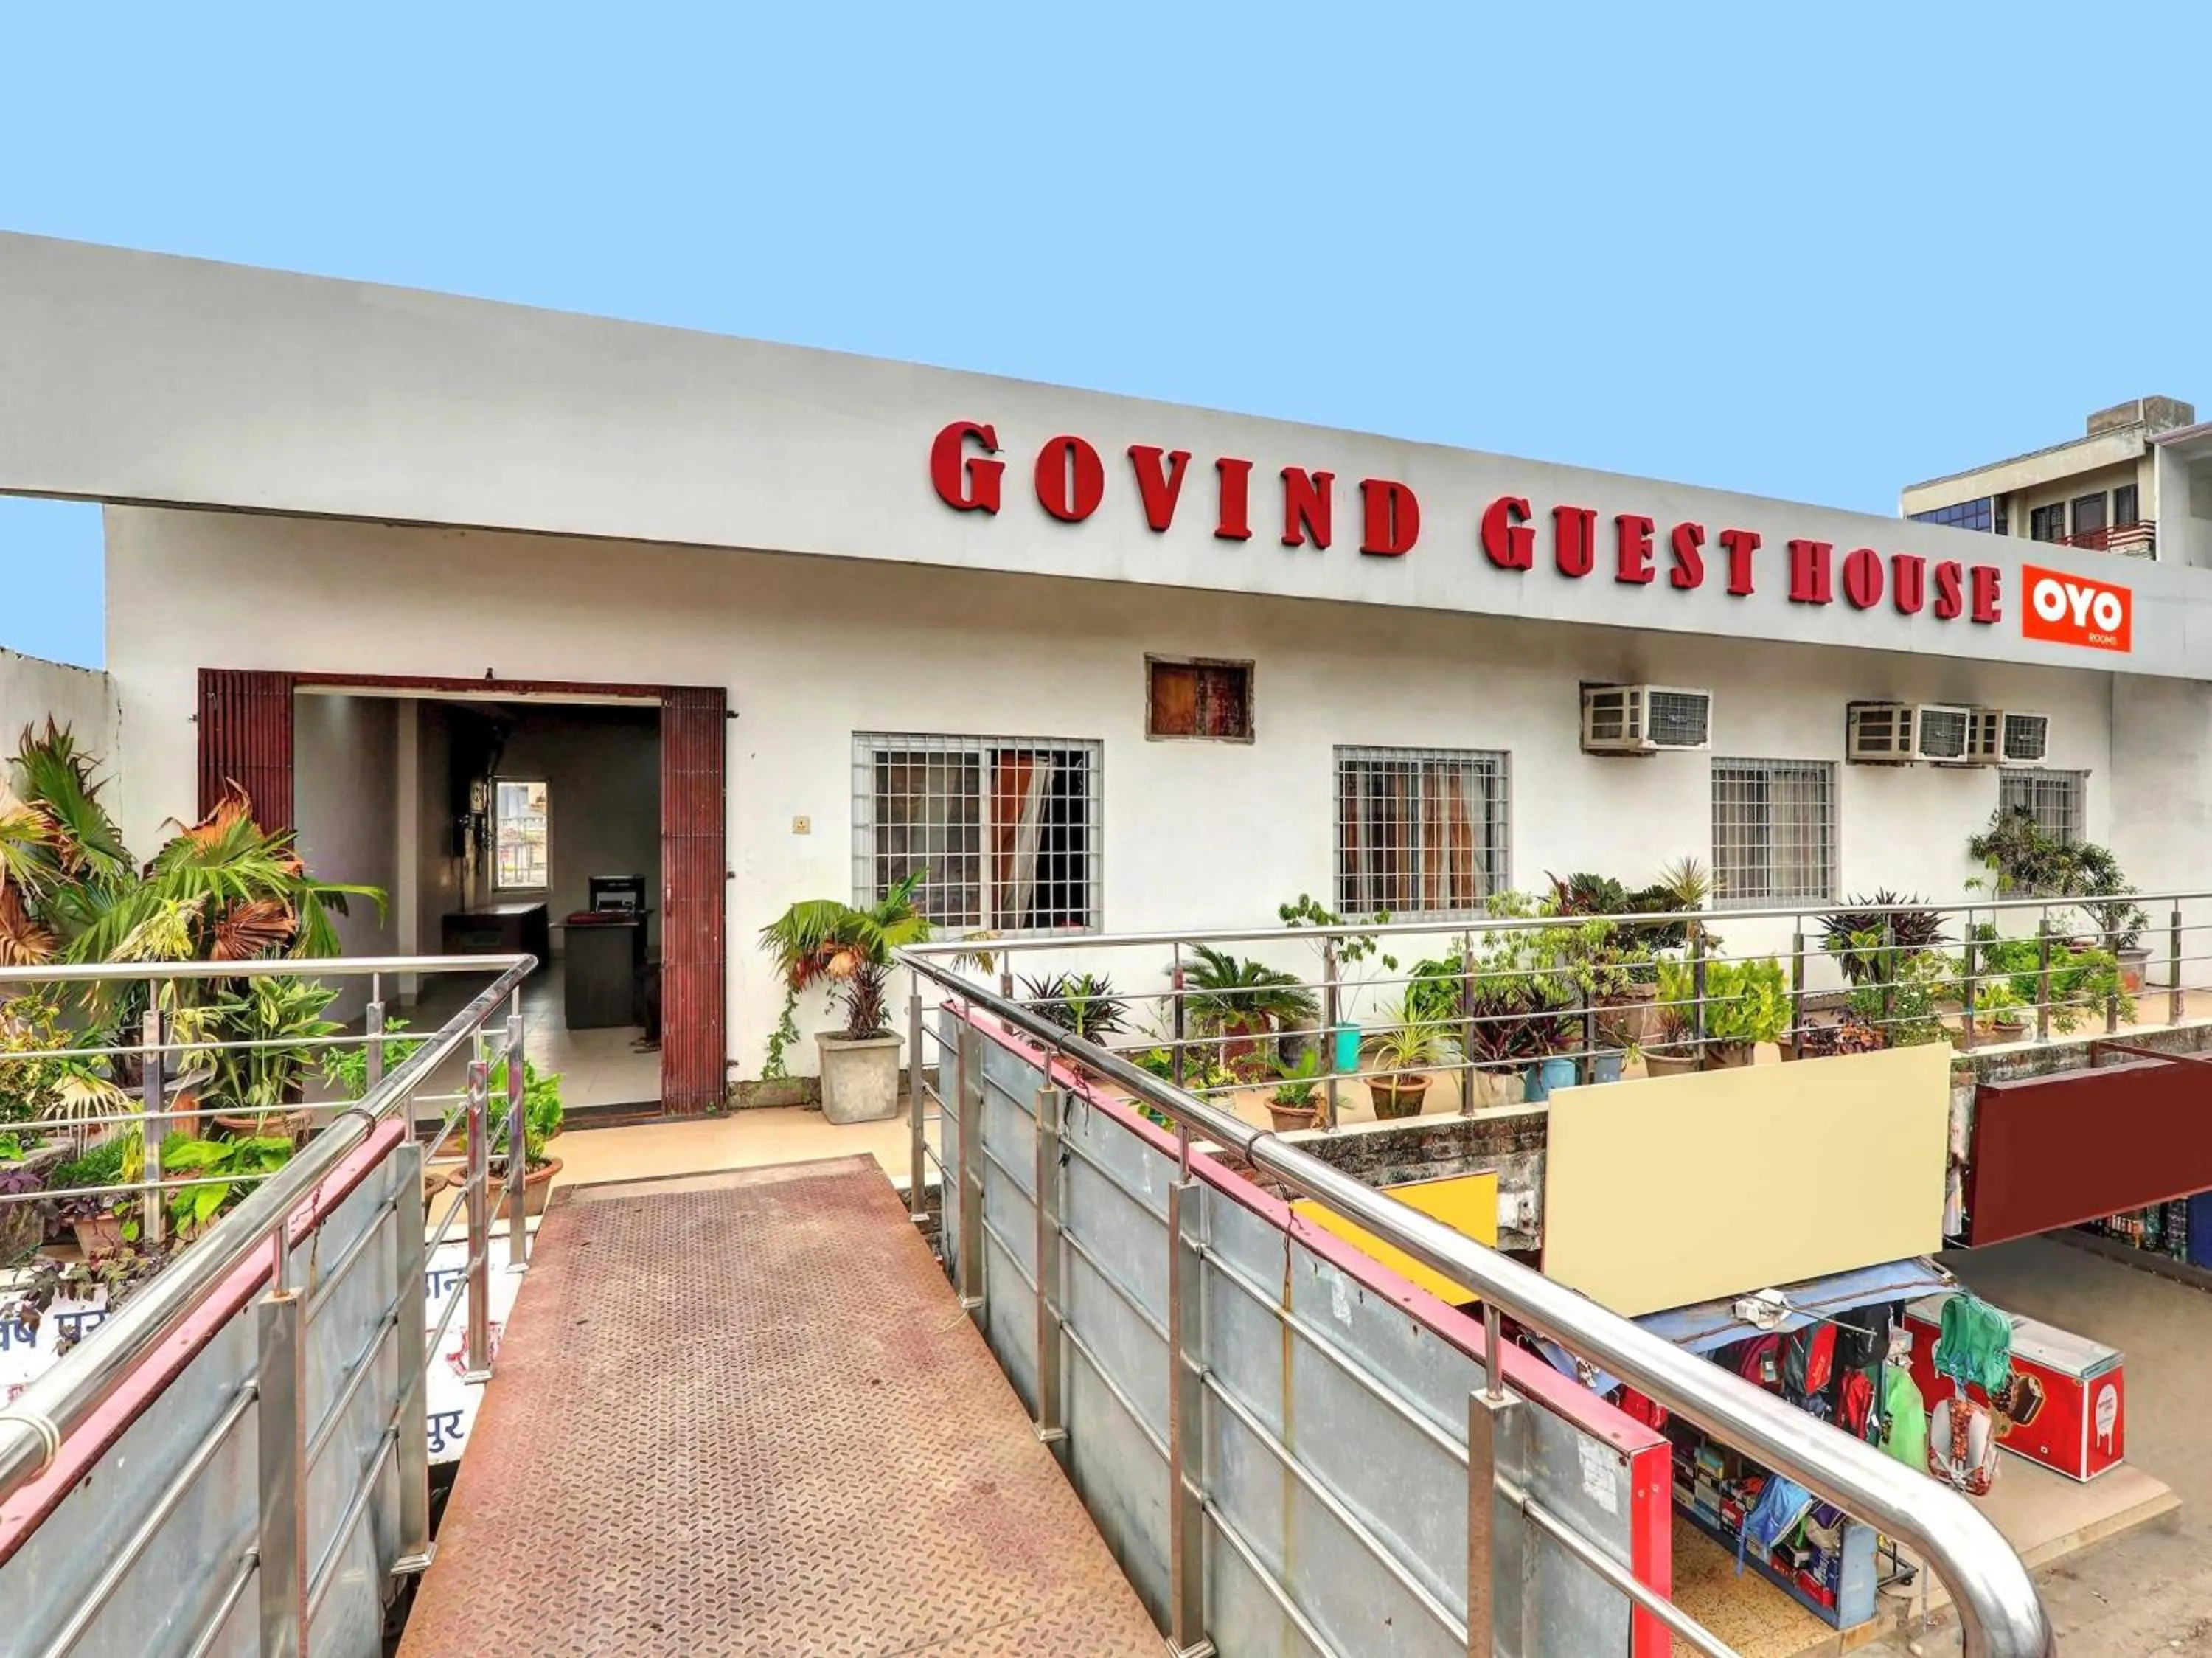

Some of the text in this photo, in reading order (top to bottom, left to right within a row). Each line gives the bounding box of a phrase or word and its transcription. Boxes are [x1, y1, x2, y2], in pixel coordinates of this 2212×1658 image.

[928, 419, 2003, 624] GOVIND GUEST HOUSE
[2032, 578, 2123, 633] OYO
